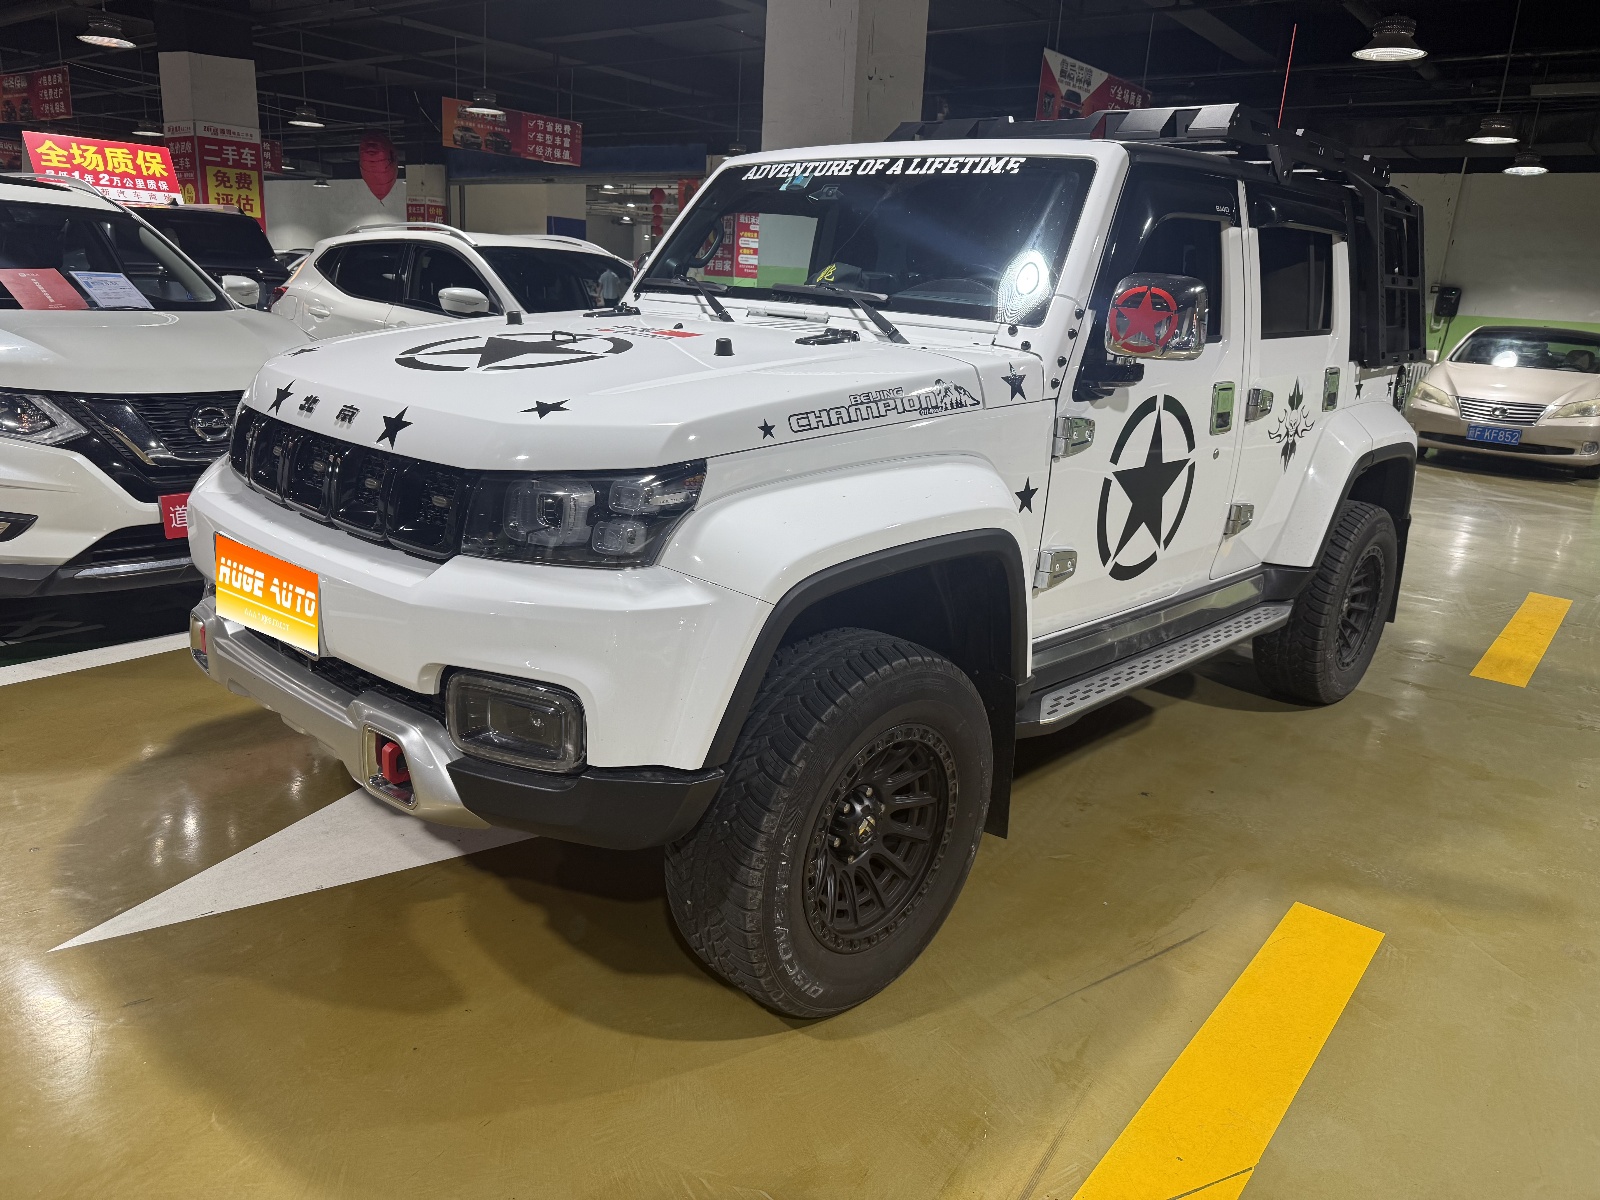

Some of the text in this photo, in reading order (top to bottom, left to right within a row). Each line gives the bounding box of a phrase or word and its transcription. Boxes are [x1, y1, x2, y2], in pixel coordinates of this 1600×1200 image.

[537, 120, 572, 136] 节省税费
[536, 131, 571, 148] 车型丰富
[35, 139, 169, 178] 全场质保
[204, 144, 257, 168] 二手车
[535, 145, 571, 160] 经济保值
[174, 158, 191, 170] 二手车
[742, 157, 1026, 180] ADVENTURE OF A LIFETIME
[213, 170, 253, 191] 免费
[214, 192, 255, 213] 评估
[849, 387, 905, 405] BEIJING
[788, 391, 941, 433] CHAMPION
[169, 505, 187, 528] 道
